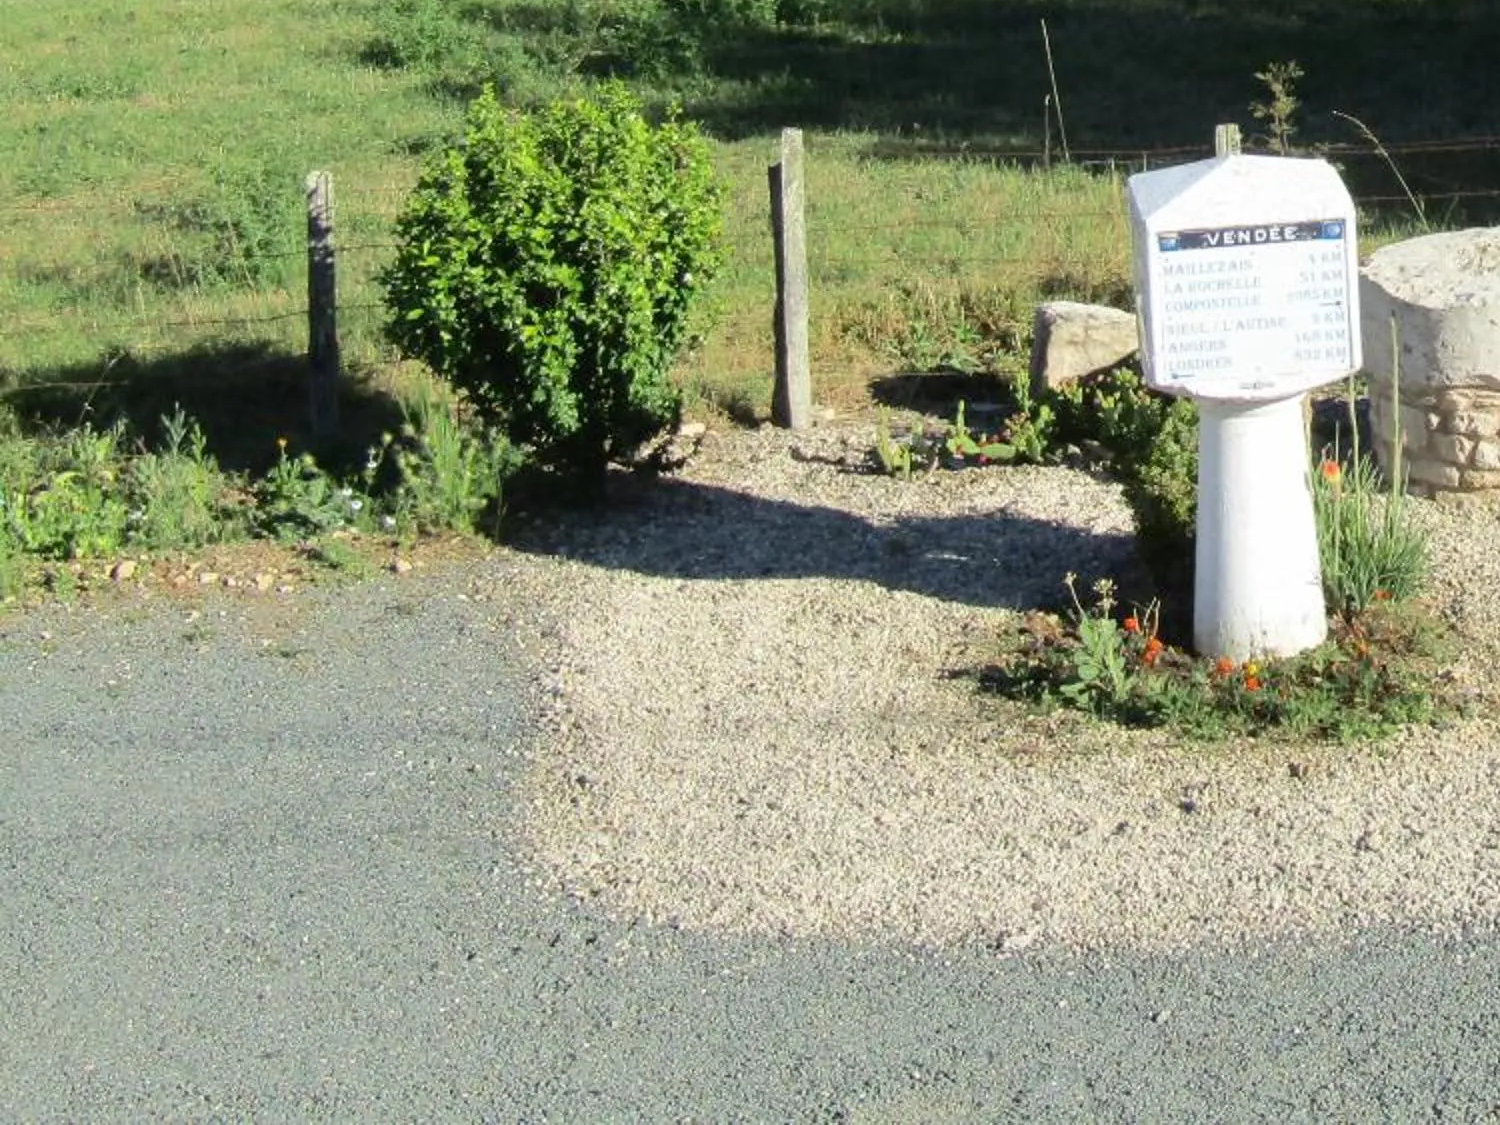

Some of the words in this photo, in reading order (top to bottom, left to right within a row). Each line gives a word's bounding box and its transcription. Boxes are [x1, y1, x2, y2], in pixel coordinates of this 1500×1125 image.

[1321, 251, 1342, 263] KM
[1164, 282, 1183, 294] LA
[1188, 276, 1262, 293] ROCHELLE
[1321, 269, 1343, 281] KM
[1323, 287, 1344, 299] KM
[1324, 311, 1345, 323] KM
[1325, 329, 1345, 341] KM
[1325, 347, 1346, 359] KM
